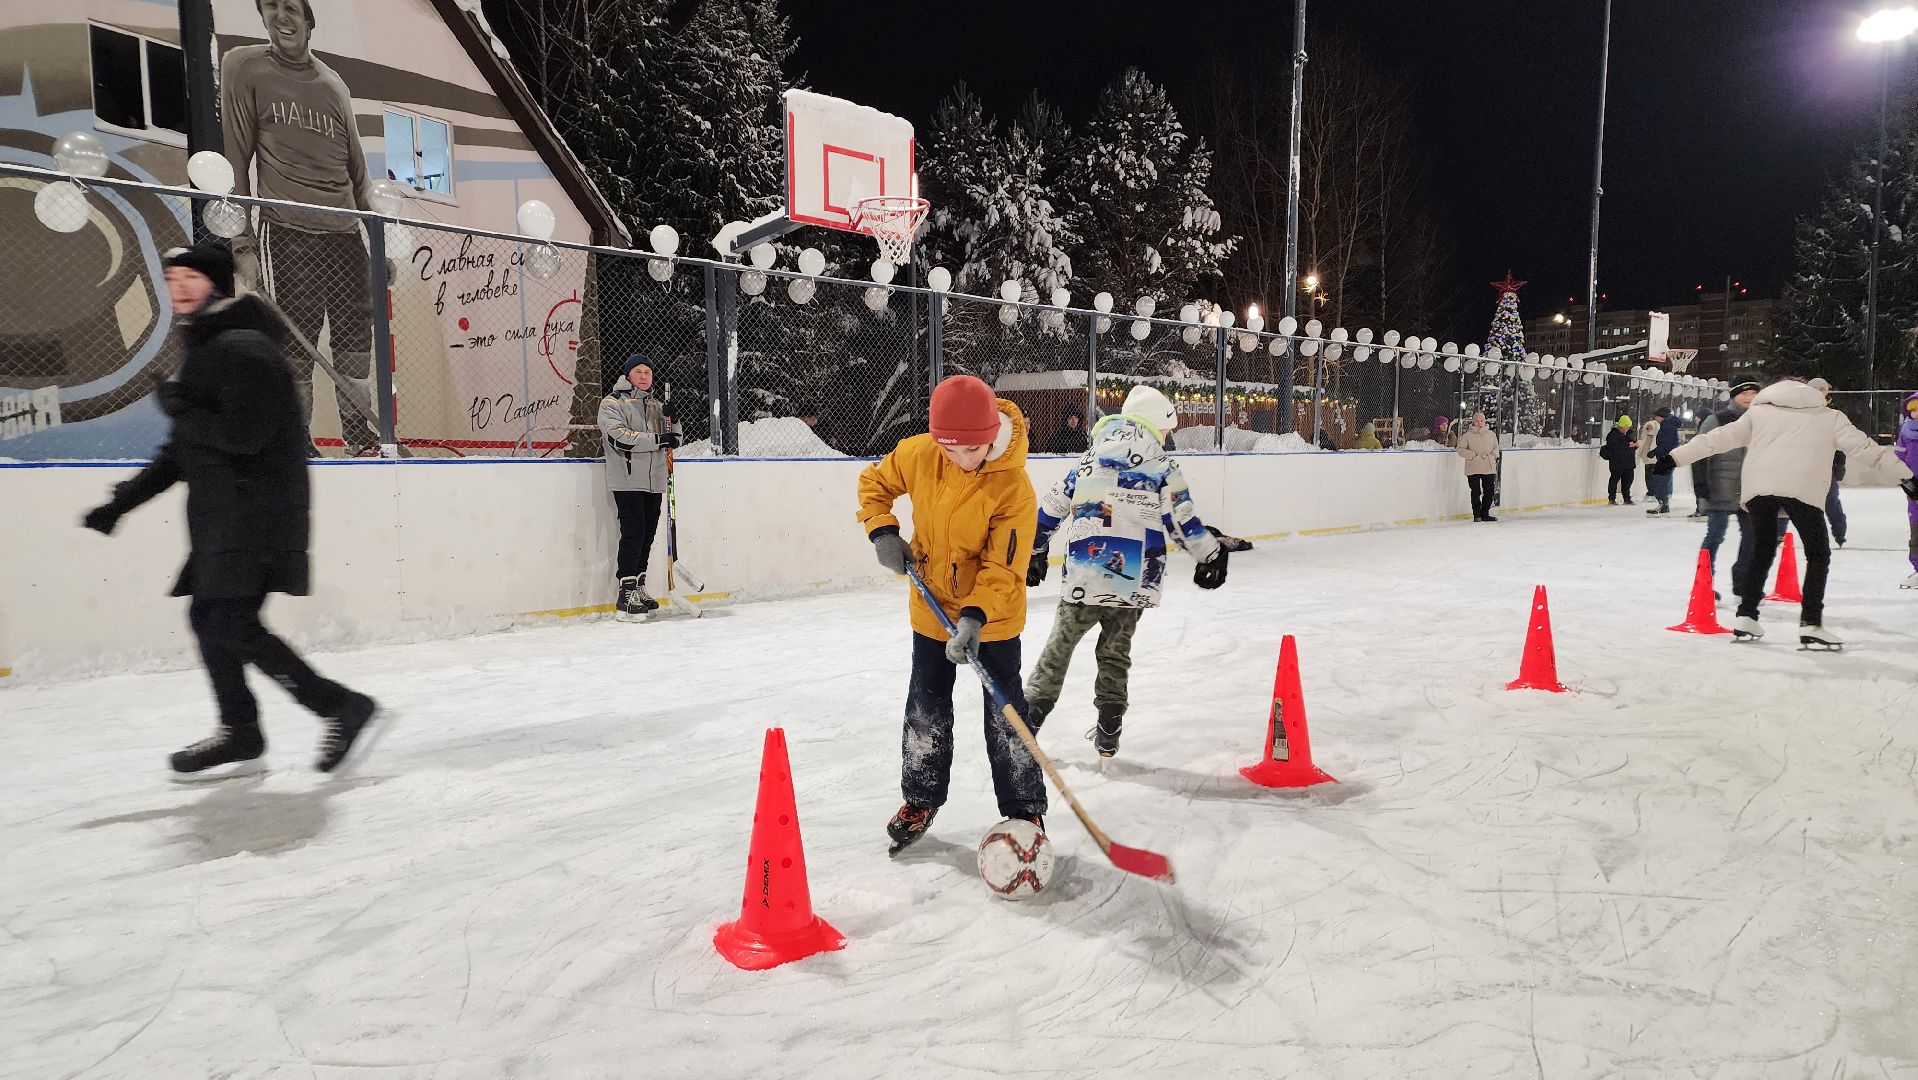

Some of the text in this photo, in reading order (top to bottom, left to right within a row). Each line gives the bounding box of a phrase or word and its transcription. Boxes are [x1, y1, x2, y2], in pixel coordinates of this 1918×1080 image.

[272, 101, 335, 138] НАШИ
[412, 234, 496, 281] Главная
[457, 268, 518, 305] человеке
[467, 334, 498, 348] это
[505, 326, 536, 341] сила
[537, 320, 574, 356] духа
[495, 393, 560, 423] Гагарин
